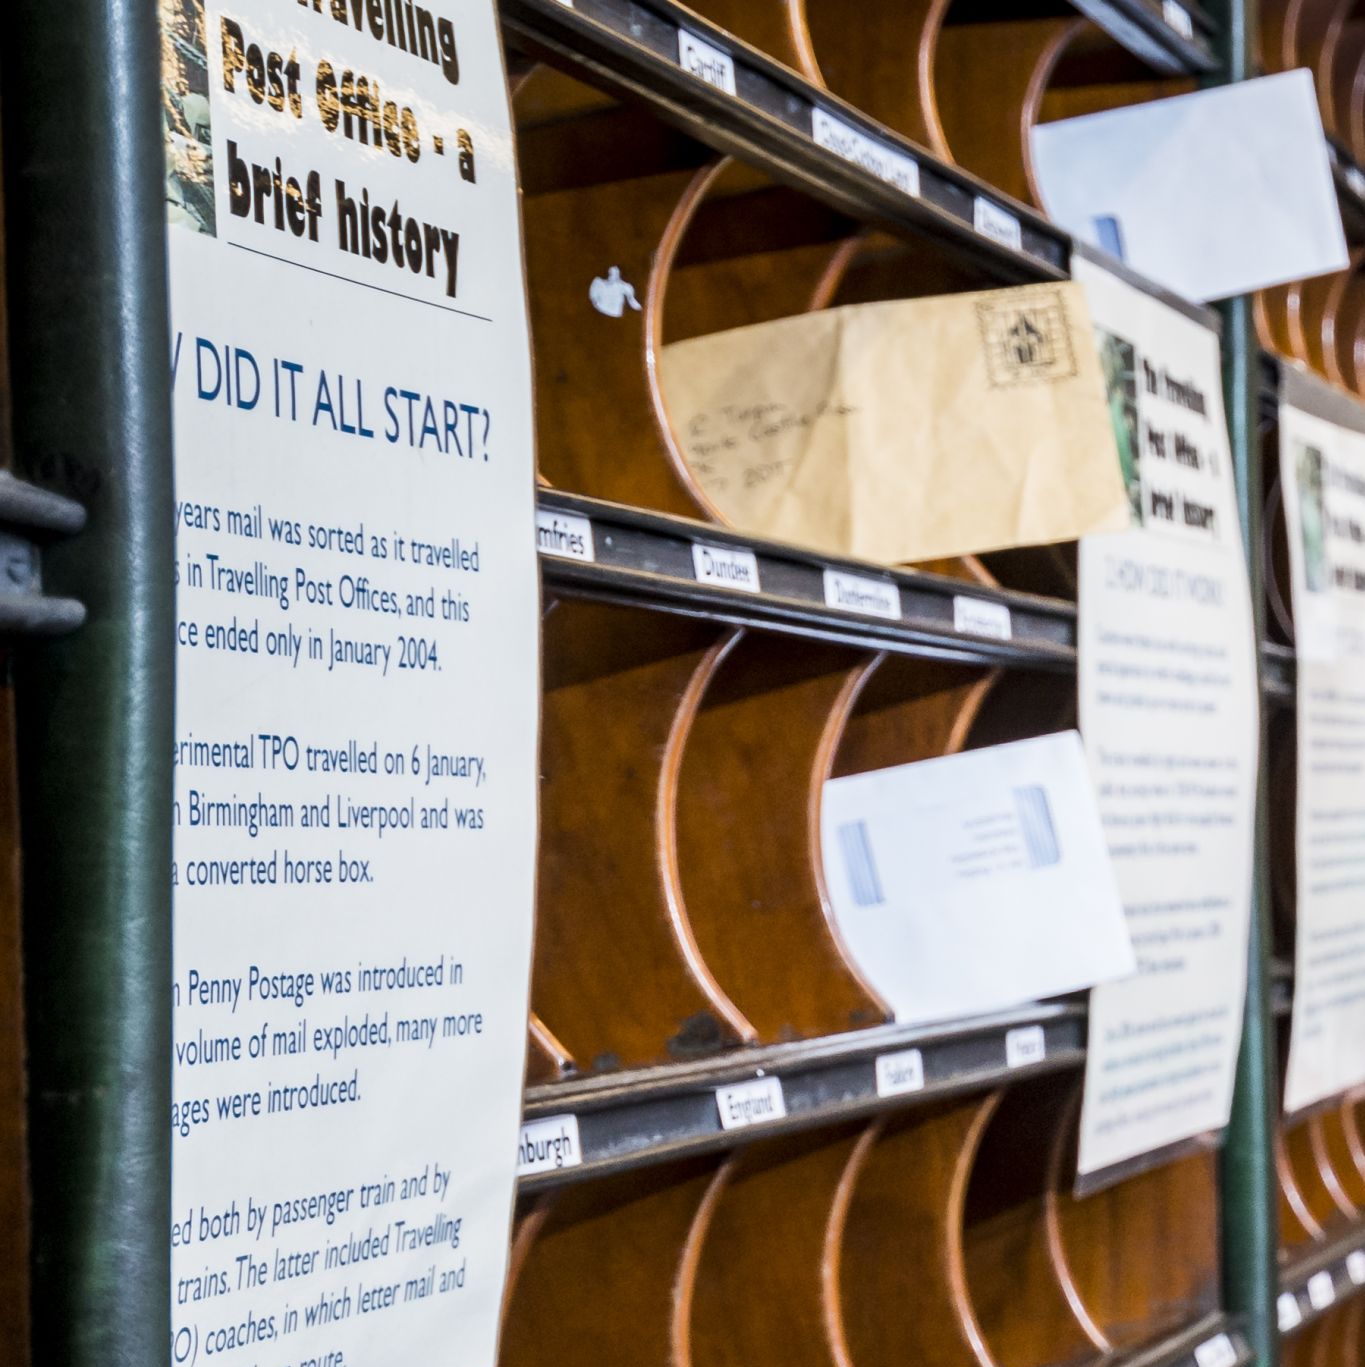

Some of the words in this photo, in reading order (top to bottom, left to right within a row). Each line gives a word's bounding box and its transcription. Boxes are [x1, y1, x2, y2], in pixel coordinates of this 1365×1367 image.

[220, 15, 303, 119] Post
[316, 58, 421, 163] Office
[432, 135, 444, 155] -
[456, 128, 476, 184] a
[226, 139, 322, 242] brief
[335, 178, 460, 298] history
[196, 336, 261, 411] DID
[273, 358, 304, 421] IT
[312, 369, 374, 438] ALL
[384, 386, 490, 462] START?
[227, 505, 262, 539] mail
[269, 517, 301, 545] was
[308, 523, 364, 555] sorted
[371, 535, 387, 559] as
[394, 530, 405, 562] it
[411, 538, 479, 572] travelled
[703, 550, 750, 582] Dundee
[187, 553, 202, 588] in
[206, 553, 289, 610] Travelling
[295, 567, 333, 605] Post
[339, 574, 401, 618] Offices,
[406, 587, 434, 618] and
[441, 589, 469, 622] this
[205, 616, 258, 653] ended
[266, 623, 301, 668] only
[309, 628, 322, 660] in
[328, 628, 391, 676] January
[398, 636, 442, 671] 2004.
[258, 734, 299, 770] TPO
[306, 740, 377, 774] travelled
[384, 753, 404, 774] on
[411, 744, 420, 775] 6
[425, 744, 486, 787] January,
[189, 790, 293, 837] Birmingham
[301, 794, 330, 828] and
[338, 795, 414, 838] Liverpool
[421, 798, 448, 829] and
[455, 808, 484, 829] was
[186, 850, 277, 885] converted
[284, 850, 332, 884] horse
[339, 850, 373, 883] box.
[189, 970, 241, 1013] Penny
[249, 966, 314, 1007] Postage
[321, 970, 351, 995] was
[358, 954, 444, 992] introduced
[450, 956, 463, 985] in
[176, 1029, 241, 1066] volume
[249, 1022, 268, 1058] of
[273, 1019, 306, 1055] mail
[313, 1011, 391, 1060] exploded,
[396, 1017, 437, 1049] many
[443, 1013, 483, 1037] more
[217, 1090, 261, 1120] were
[268, 1068, 360, 1113] introduced.
[199, 1200, 240, 1242] both
[247, 1197, 267, 1240] by
[272, 1189, 354, 1237] passenger
[360, 1174, 395, 1208] train
[400, 1164, 428, 1200] and
[434, 1163, 451, 1201] by
[178, 1266, 231, 1304] trains.
[236, 1254, 267, 1290] The
[273, 1248, 319, 1282] latter
[325, 1224, 390, 1270] included
[395, 1213, 462, 1253] Travelling
[205, 1311, 278, 1355] coaches,
[283, 1303, 298, 1334] in
[305, 1286, 350, 1327] which
[357, 1283, 400, 1314] letter
[404, 1264, 436, 1302] mail
[439, 1257, 466, 1294] and
